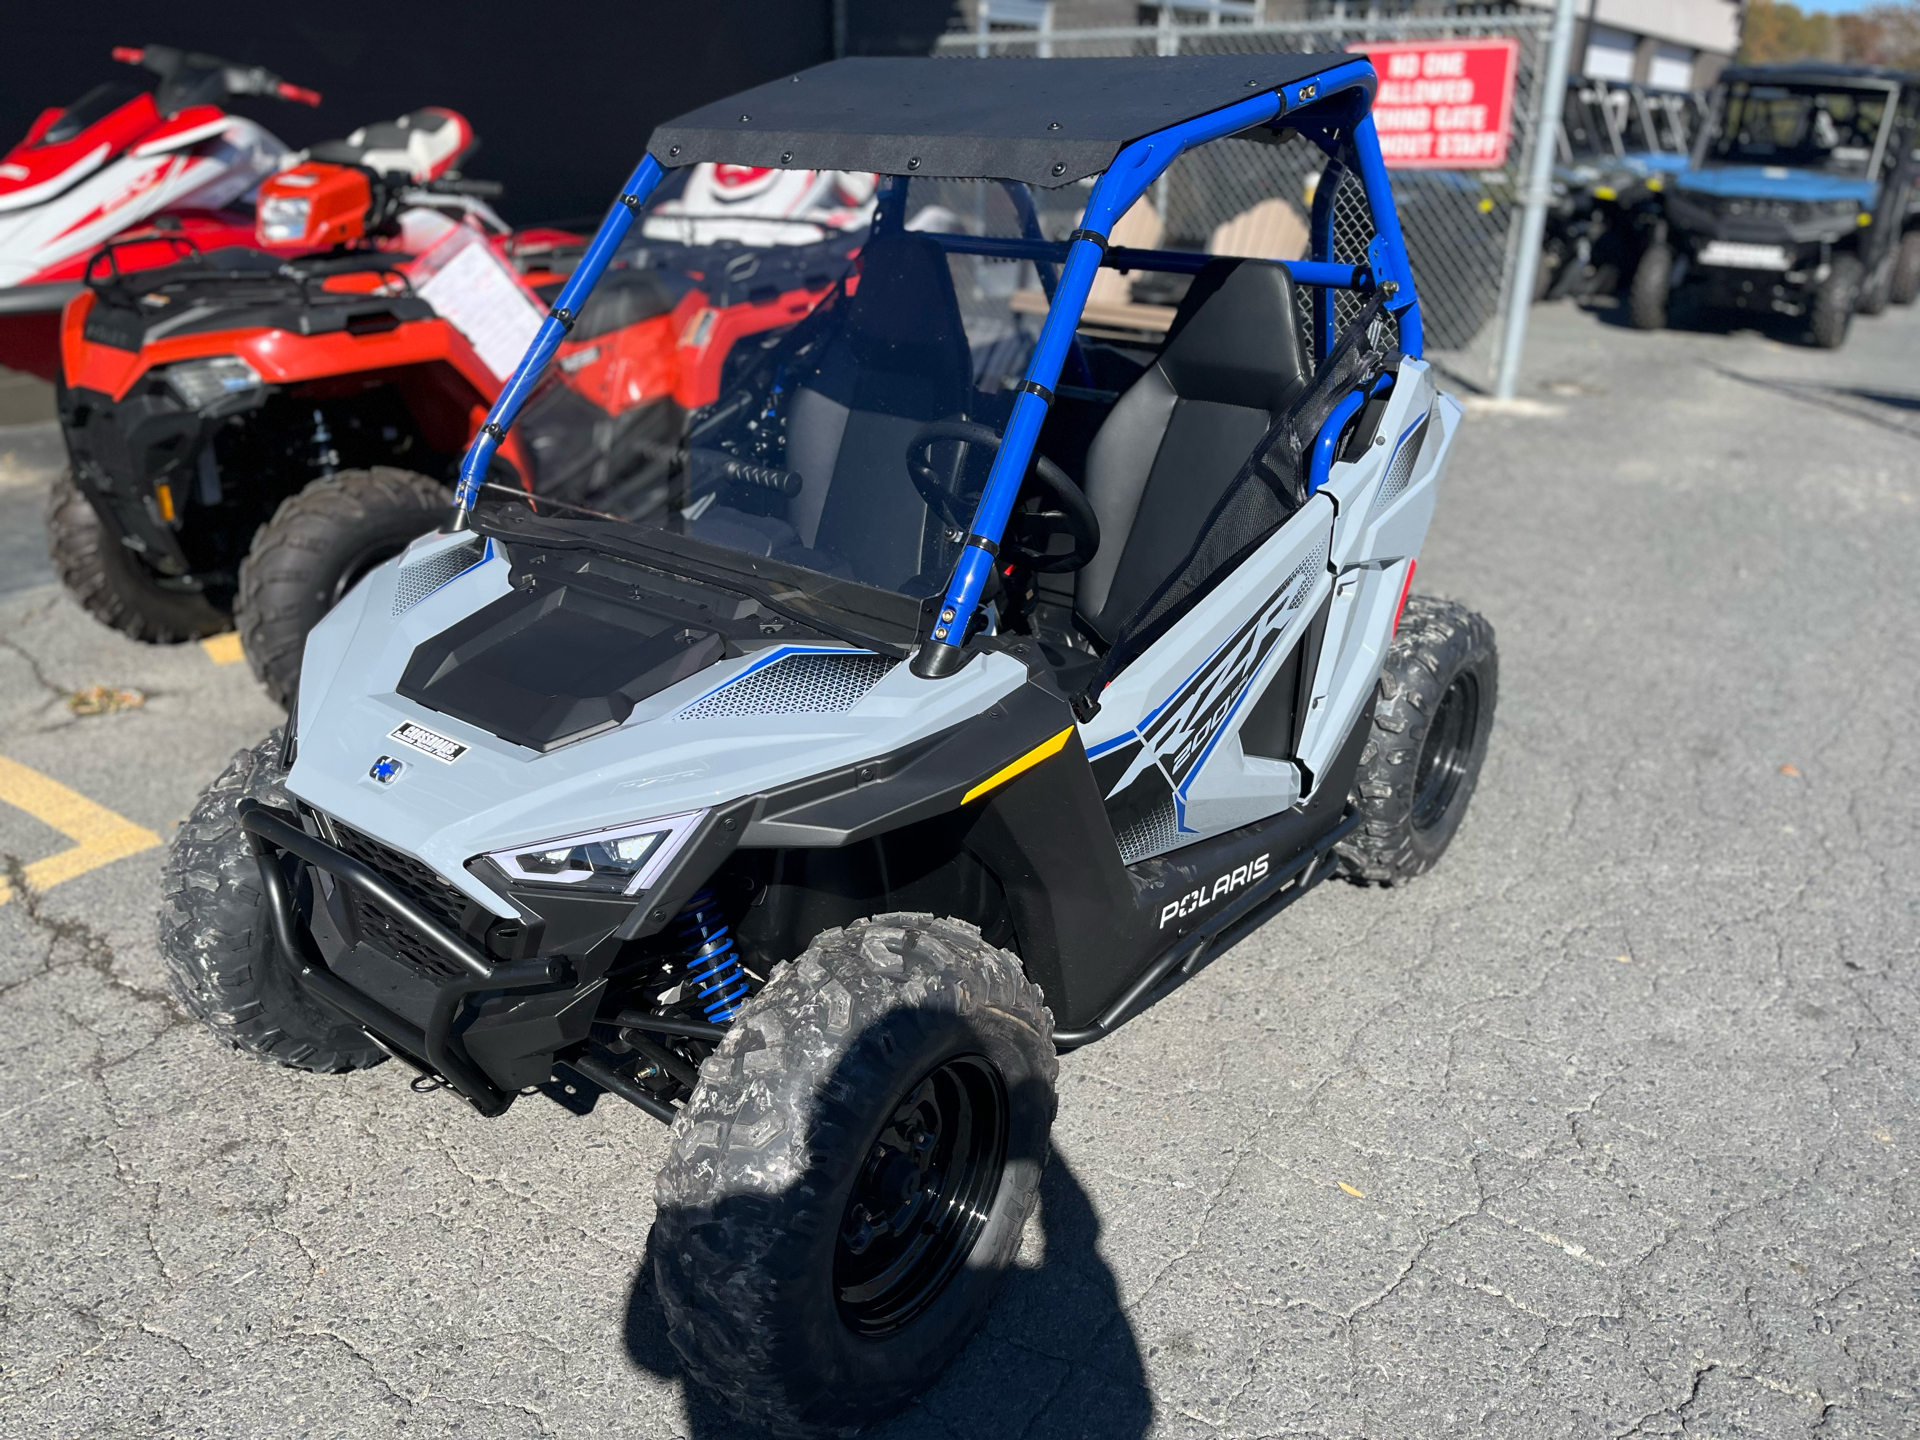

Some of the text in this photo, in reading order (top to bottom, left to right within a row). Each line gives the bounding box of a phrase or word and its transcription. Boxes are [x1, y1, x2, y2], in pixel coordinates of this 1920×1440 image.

[1389, 52, 1466, 78] NO ONE
[1377, 79, 1474, 105] ALLOWED
[1373, 105, 1487, 131] EHIND GATE
[1378, 132, 1496, 157] HOUT STAFF
[1104, 573, 1308, 800] RZR
[402, 725, 460, 755] CROSSROADS
[1172, 695, 1231, 775] 200
[1159, 853, 1270, 929] POLARIS
